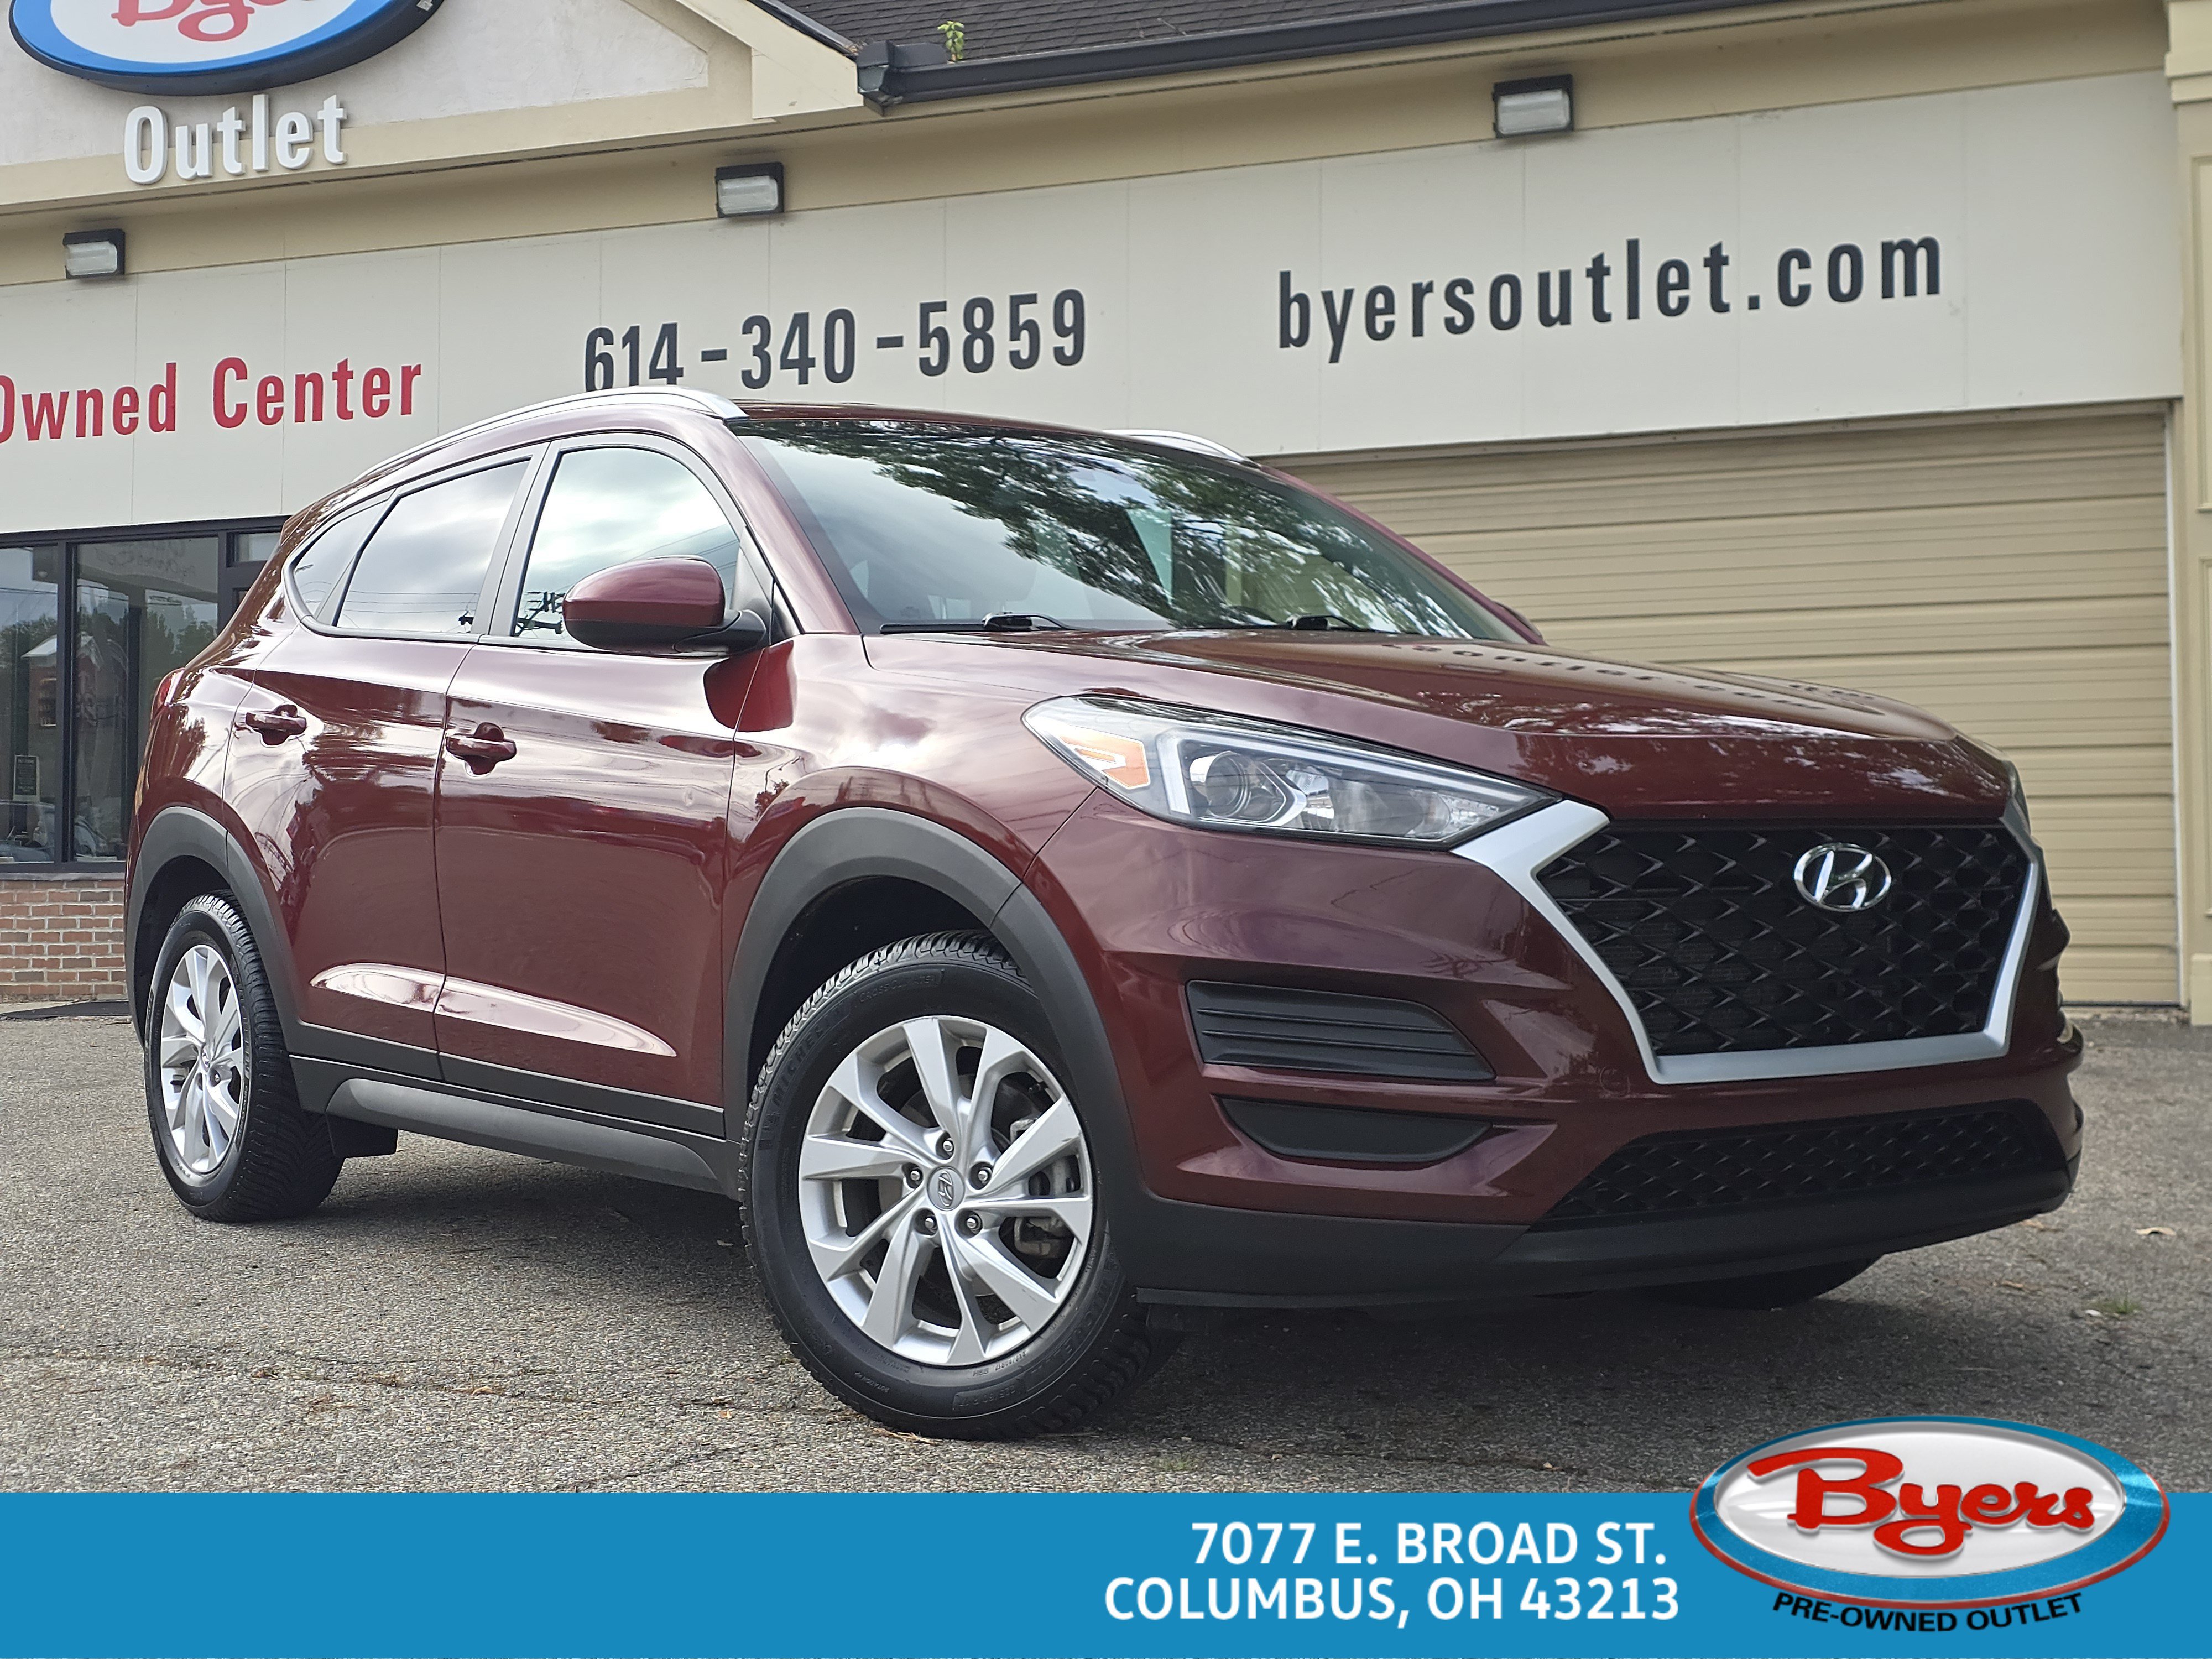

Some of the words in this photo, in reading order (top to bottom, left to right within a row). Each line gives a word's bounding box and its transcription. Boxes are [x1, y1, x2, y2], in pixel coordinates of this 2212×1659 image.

[124, 93, 347, 185] Outlet
[1279, 237, 1940, 364] byersoutlet.com
[213, 357, 421, 428] Center
